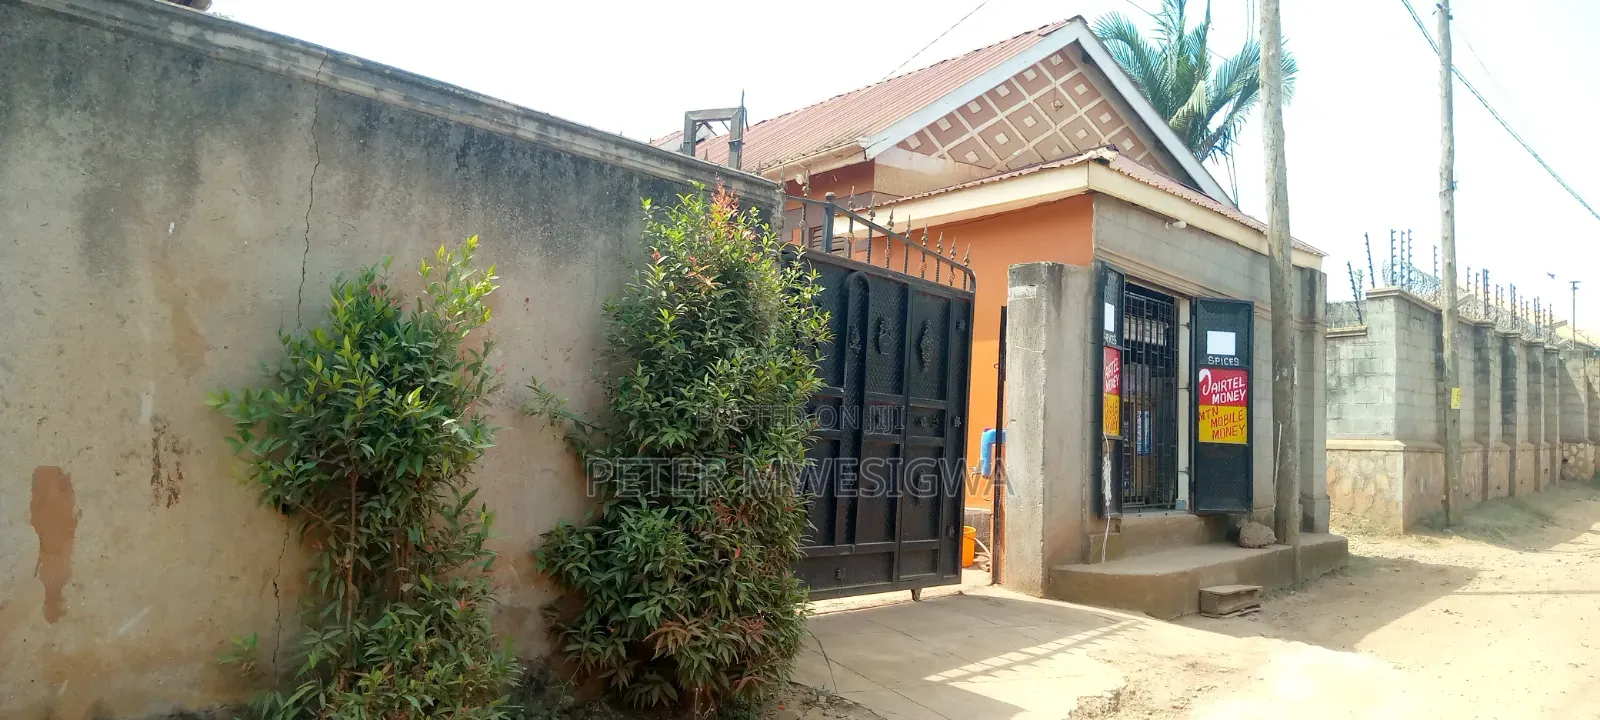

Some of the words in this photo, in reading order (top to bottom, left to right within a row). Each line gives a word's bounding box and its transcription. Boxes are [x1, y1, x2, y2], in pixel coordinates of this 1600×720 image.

[1207, 356, 1240, 366] SPICES
[1211, 376, 1246, 394] AIRTEL
[1211, 389, 1246, 405] MONEY
[1198, 406, 1219, 421] MTN
[1210, 409, 1245, 429] MOBILE
[1211, 424, 1246, 440] MONEY
